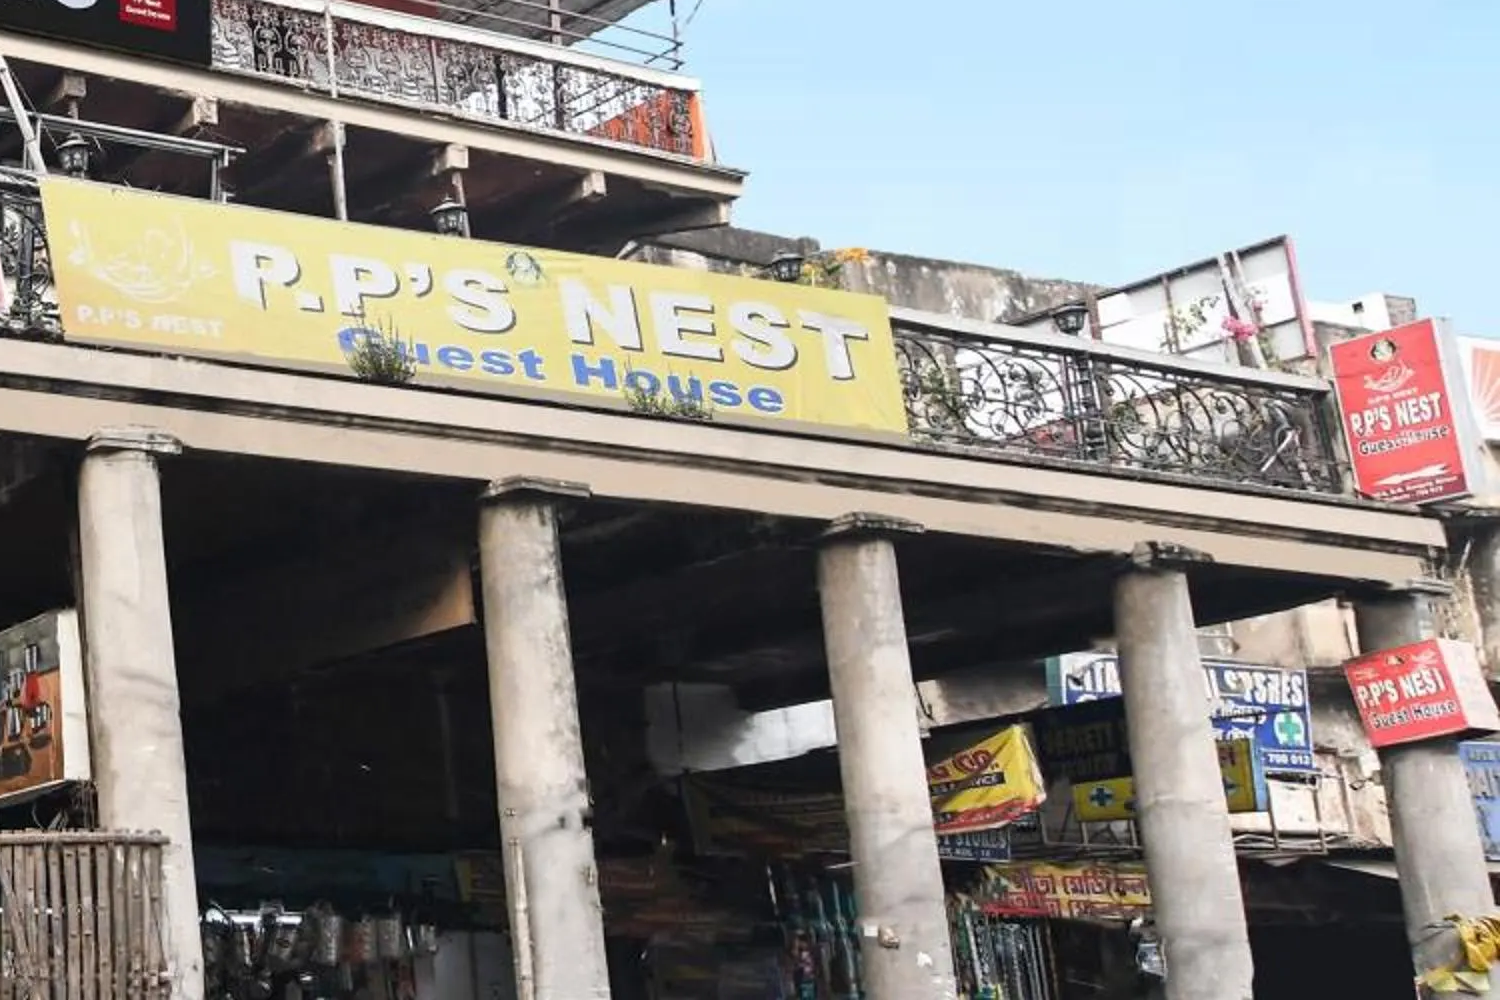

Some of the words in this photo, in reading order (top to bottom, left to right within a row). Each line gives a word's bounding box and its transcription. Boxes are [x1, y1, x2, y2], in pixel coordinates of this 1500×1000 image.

[229, 240, 516, 334] P.P'S
[558, 275, 869, 380] NEST
[571, 352, 784, 413] House
[1395, 392, 1442, 427] NEST
[1356, 682, 1399, 710] P.P'S
[1400, 667, 1446, 700] NEST
